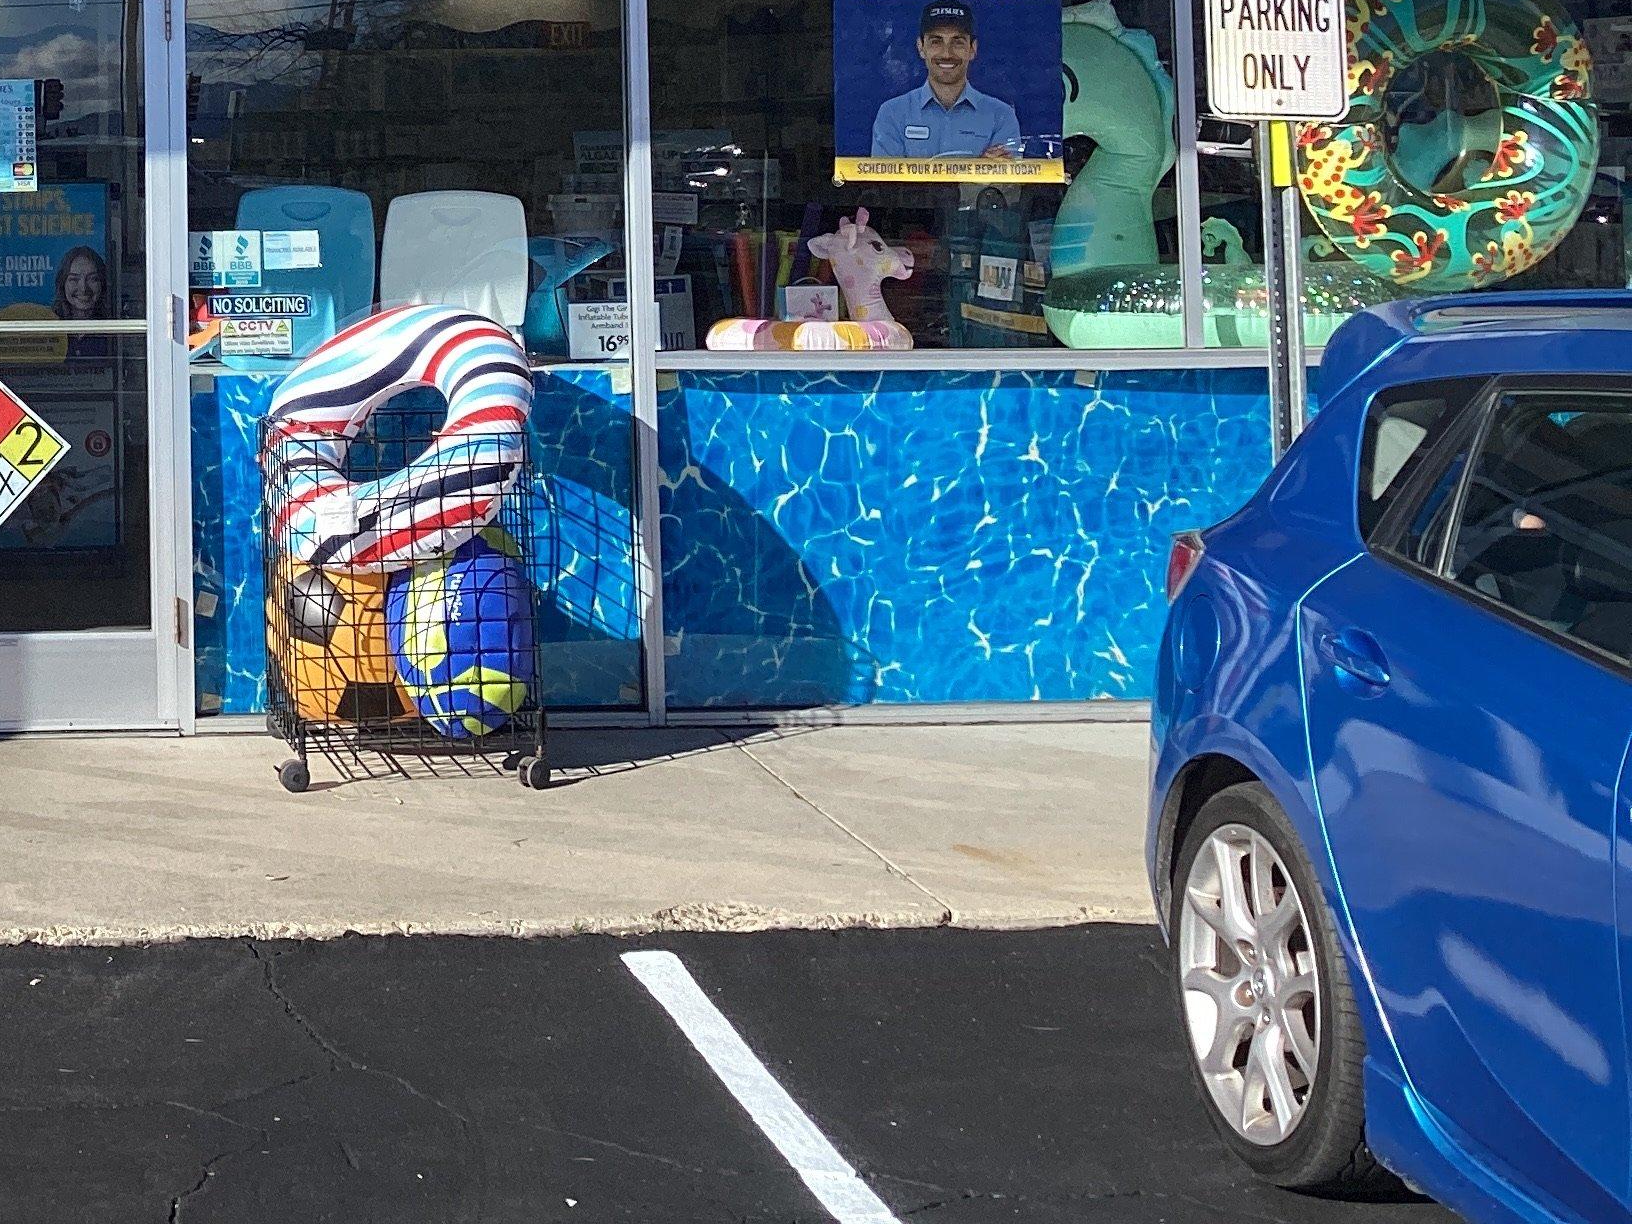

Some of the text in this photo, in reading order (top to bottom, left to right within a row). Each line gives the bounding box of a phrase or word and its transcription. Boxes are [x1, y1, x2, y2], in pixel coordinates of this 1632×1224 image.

[551, 23, 584, 46] EXIT
[1243, 53, 1311, 91] ONLY
[857, 162, 1042, 175] SCHEDULE YOUR AT-HOME REPAIR TODAY!
[18, 213, 95, 237] SCIENCE
[5, 255, 54, 271] DIGITAL
[193, 261, 216, 271] BBB
[229, 260, 253, 270] BBB
[16, 271, 45, 287] TEST
[212, 297, 305, 314] NO SOLICITING
[238, 320, 274, 332] CCTV
[15, 421, 44, 467] 2
